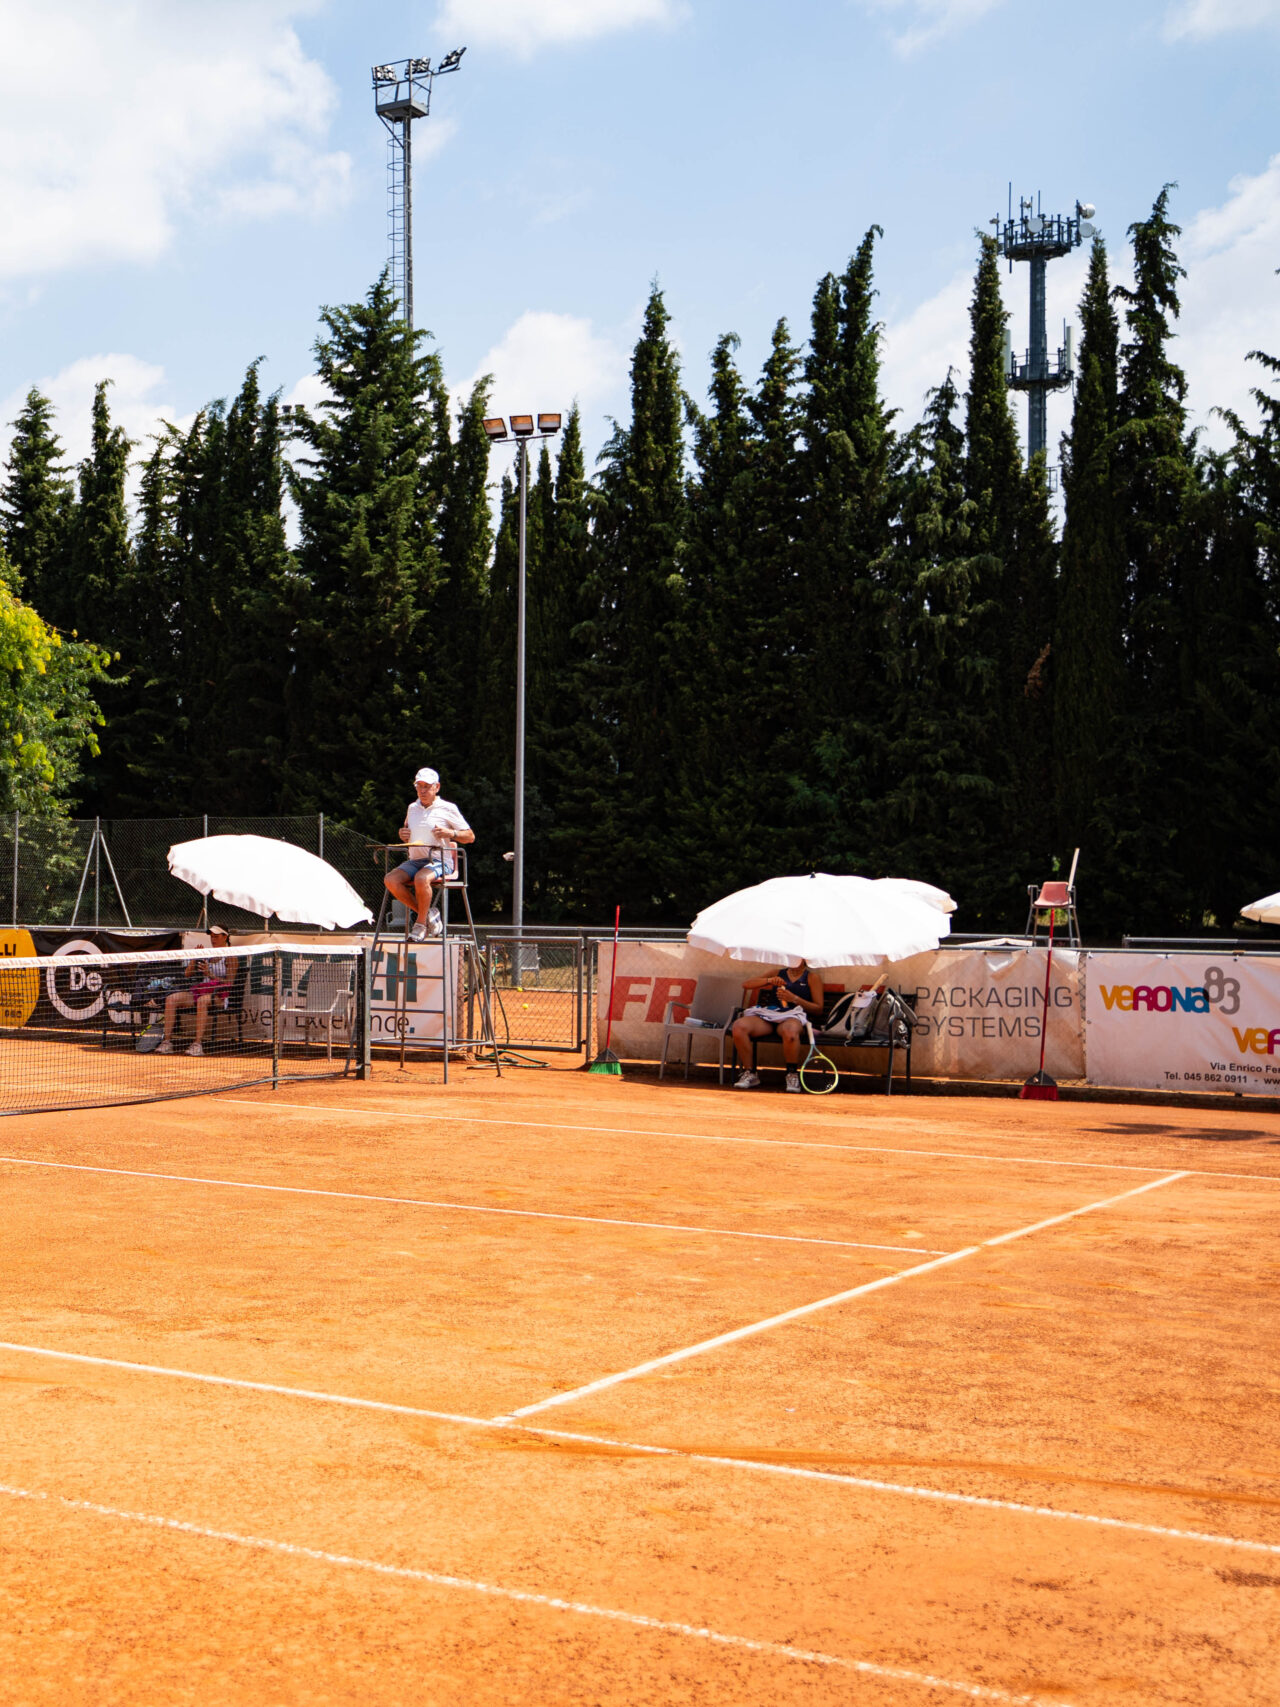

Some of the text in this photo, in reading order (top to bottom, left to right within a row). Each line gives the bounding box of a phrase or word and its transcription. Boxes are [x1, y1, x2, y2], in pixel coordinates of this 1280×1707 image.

[915, 986, 1073, 1008] PACKAGING
[1204, 966, 1241, 1015] 83
[915, 1016, 1041, 1037] SYSTEMS
[1164, 1071, 1181, 1080] Tel.
[1184, 1072, 1202, 1081] 045
[1204, 1073, 1222, 1082] 862
[1224, 1074, 1248, 1083] 0911
[1210, 1062, 1226, 1071] Via
[1229, 1063, 1262, 1073] Enrico
